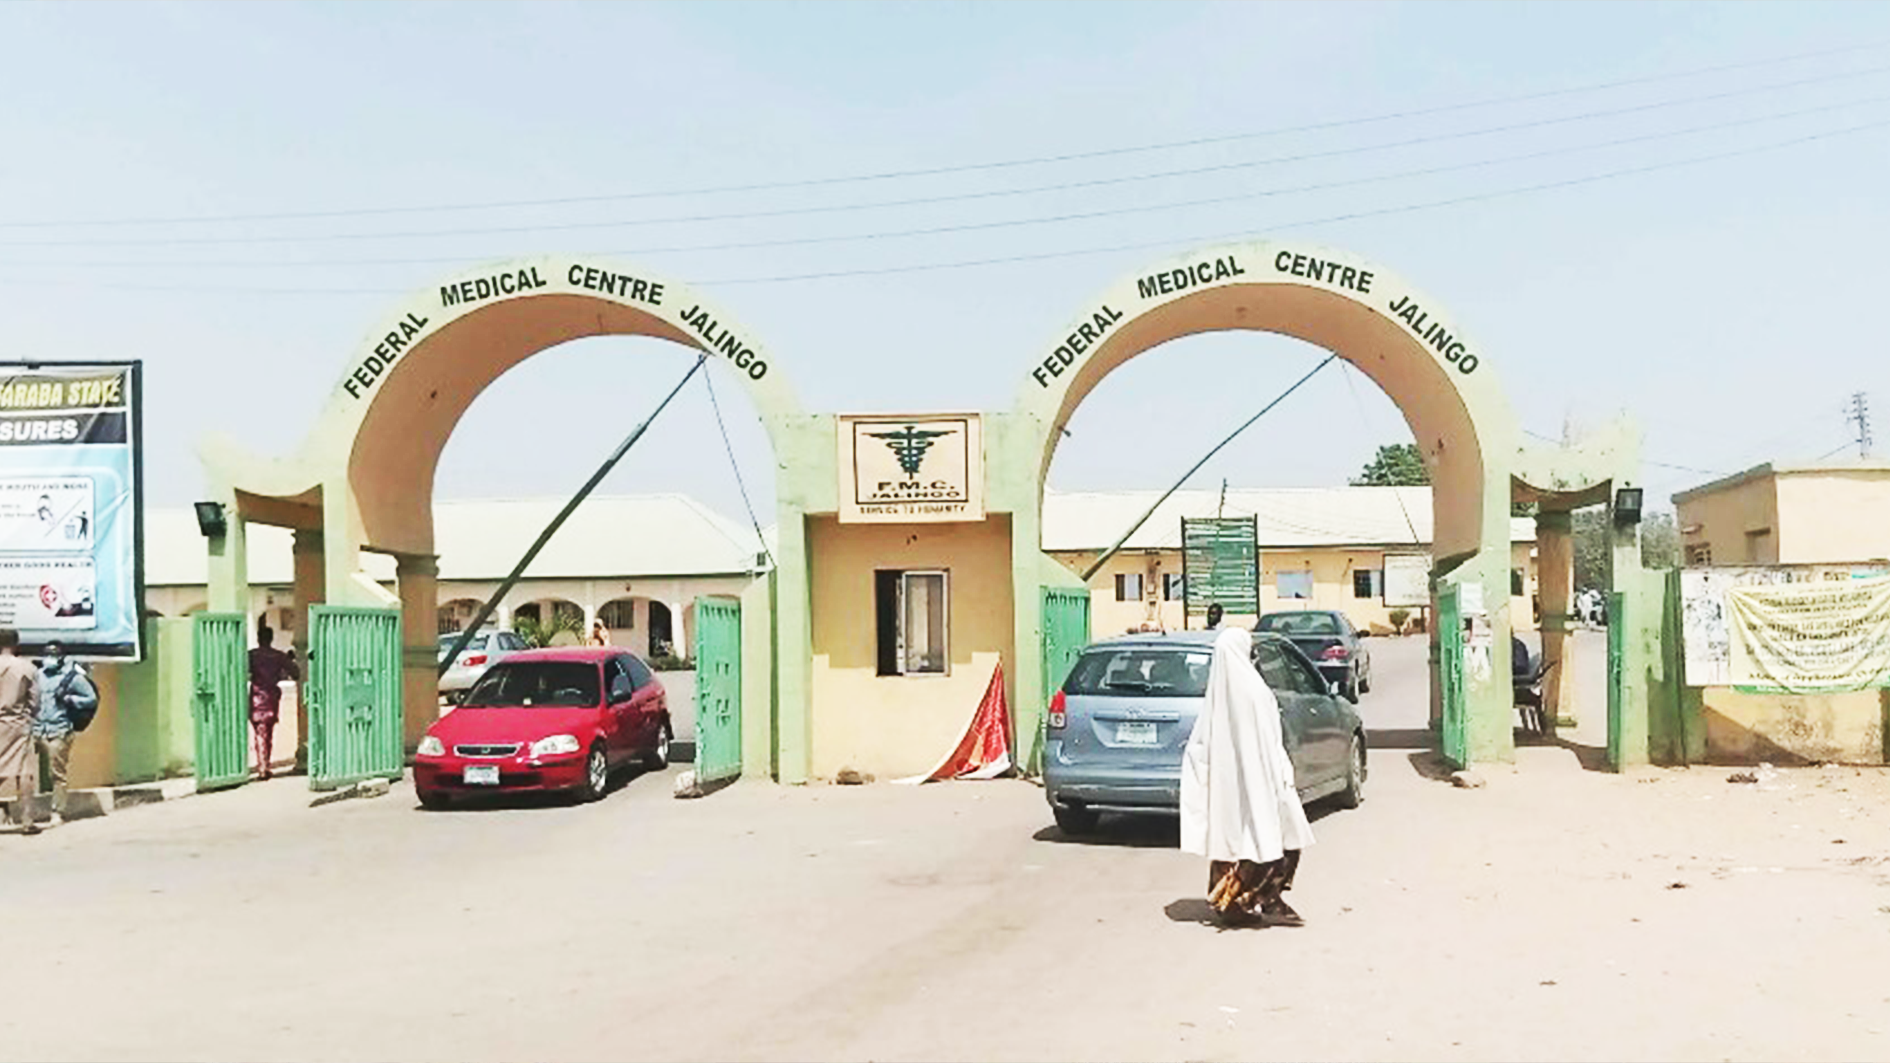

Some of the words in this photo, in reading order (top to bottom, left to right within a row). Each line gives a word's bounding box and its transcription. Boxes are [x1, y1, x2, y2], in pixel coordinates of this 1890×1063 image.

[343, 312, 429, 400] FEDERAL
[440, 266, 547, 307] MEDICAL
[568, 264, 664, 306] CENTRE
[680, 304, 768, 381] JALINGO
[1032, 304, 1123, 388] FEDERAL
[1137, 255, 1245, 299] MEDICAL
[1275, 251, 1374, 294] CENTRE
[1389, 296, 1479, 375] JALINGO
[0, 420, 79, 441] SURES
[67, 380, 120, 406] STATE
